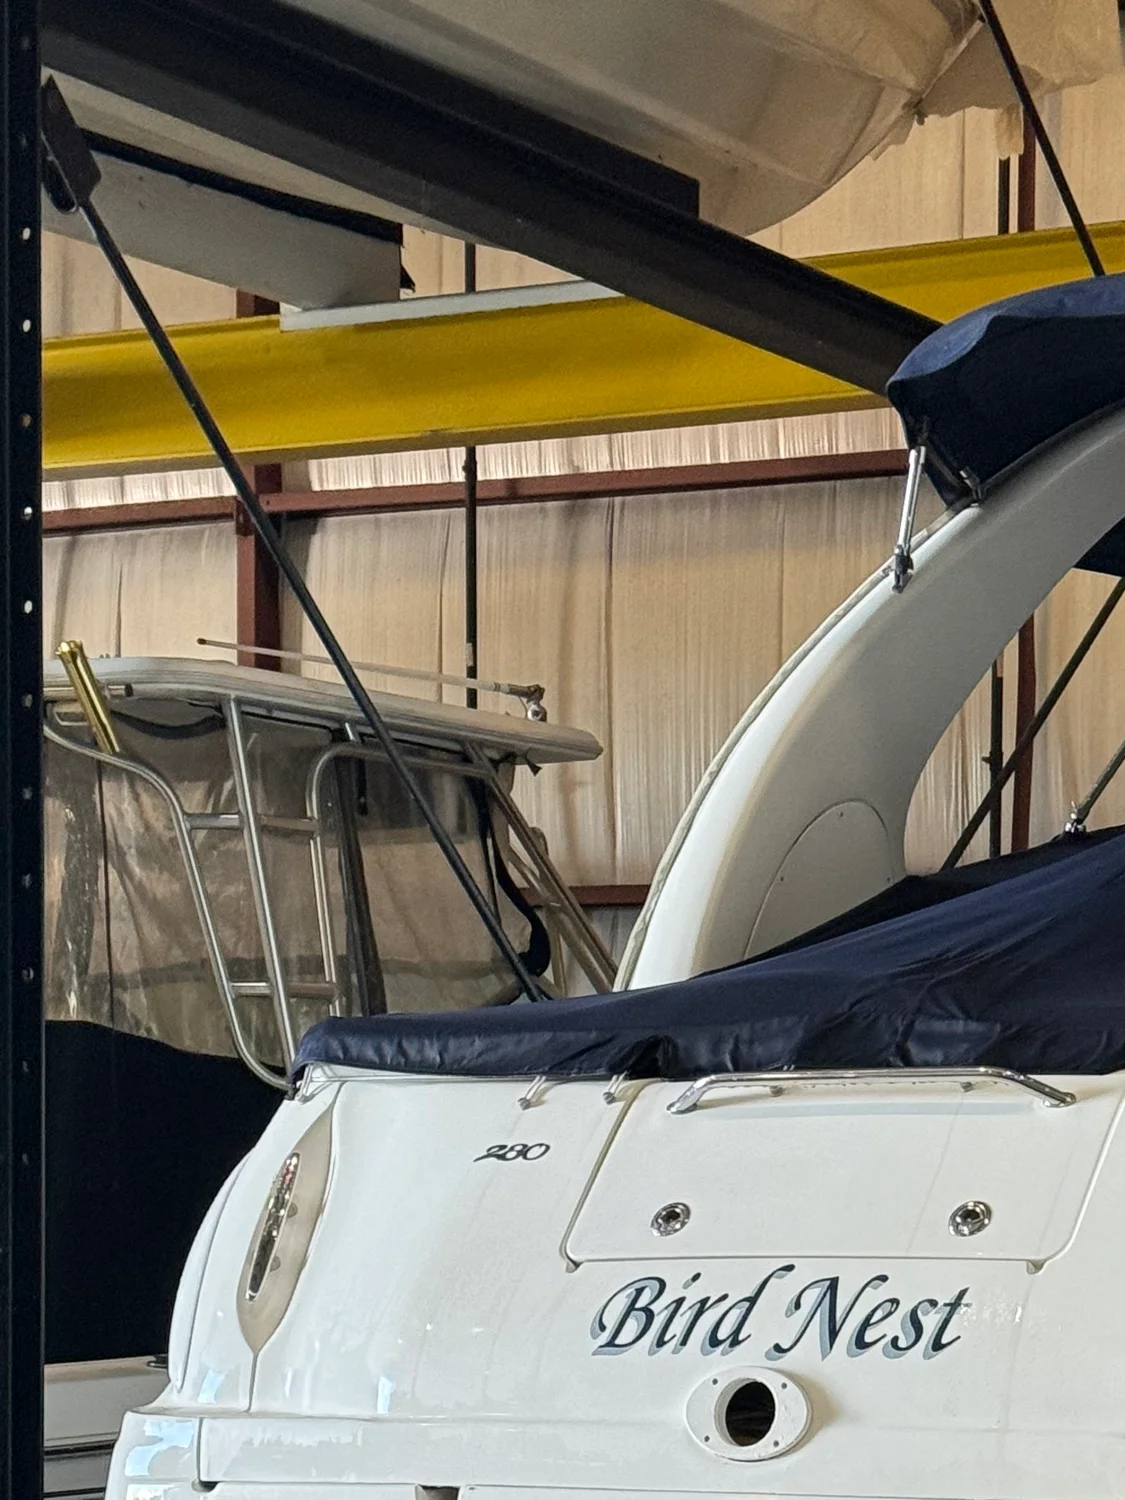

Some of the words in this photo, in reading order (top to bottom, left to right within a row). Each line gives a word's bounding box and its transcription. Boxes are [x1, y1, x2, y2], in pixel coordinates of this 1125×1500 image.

[472, 1142, 551, 1162] 280
[589, 1263, 796, 1357] Bird
[764, 1274, 971, 1362] Nest
